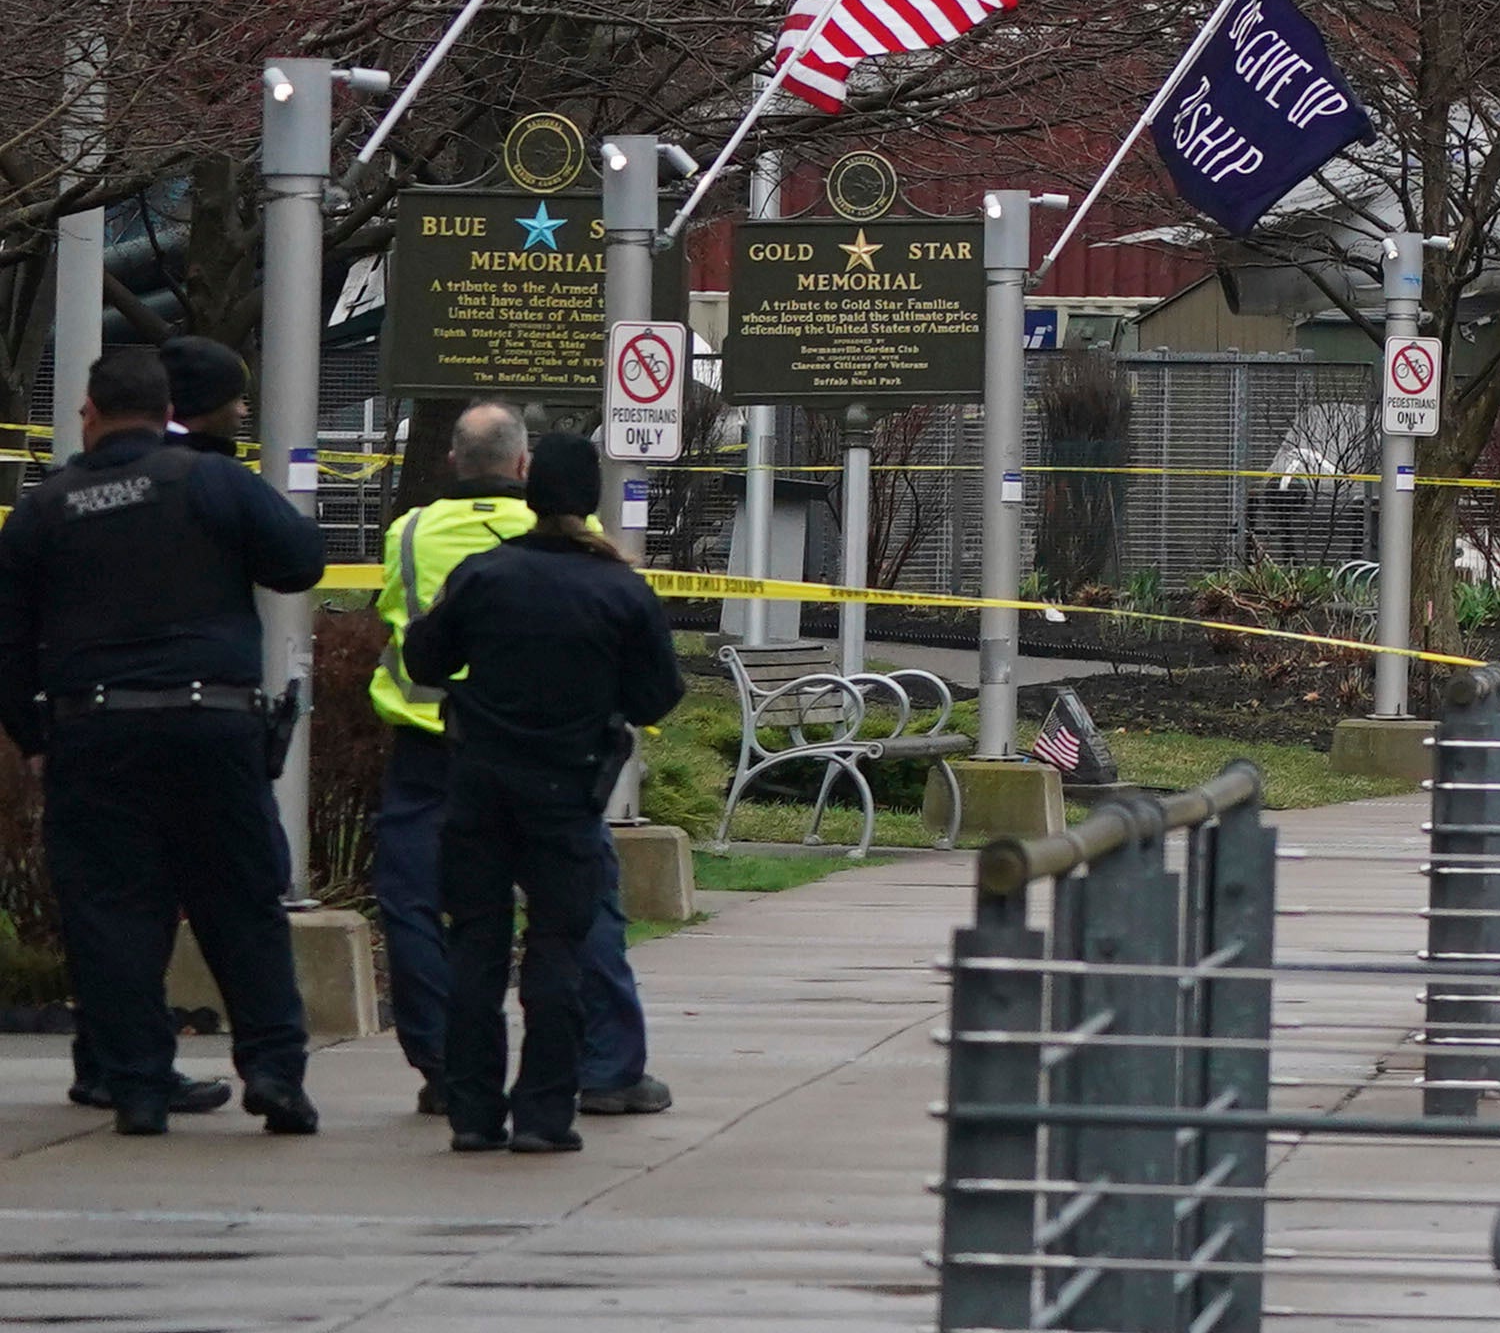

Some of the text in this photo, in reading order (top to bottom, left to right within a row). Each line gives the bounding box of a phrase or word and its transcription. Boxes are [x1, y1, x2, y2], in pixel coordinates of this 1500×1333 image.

[1235, 30, 1313, 109] GIVE
[1287, 76, 1349, 130] UP
[1176, 102, 1264, 183] SHIP
[421, 216, 487, 237] BLUE
[748, 242, 972, 262] GOLD STAR
[470, 251, 607, 273] MEMORIAL
[430, 279, 598, 295] A tribute to the Armed
[797, 272, 922, 291] MEMORIAL
[457, 294, 487, 306] that
[491, 294, 523, 307] have
[529, 296, 593, 309] defended
[760, 298, 960, 311] A tribute to Gold Star Families
[448, 307, 605, 323] United States of Amer
[742, 310, 978, 325] whose loved one paid the ultimate price
[741, 322, 979, 337] defending the United States of America
[1387, 396, 1437, 410] PEDESTRIANS
[612, 407, 678, 424] PEDESTRIANS
[1397, 411, 1426, 425] ONLY
[625, 427, 664, 446] ONLY
